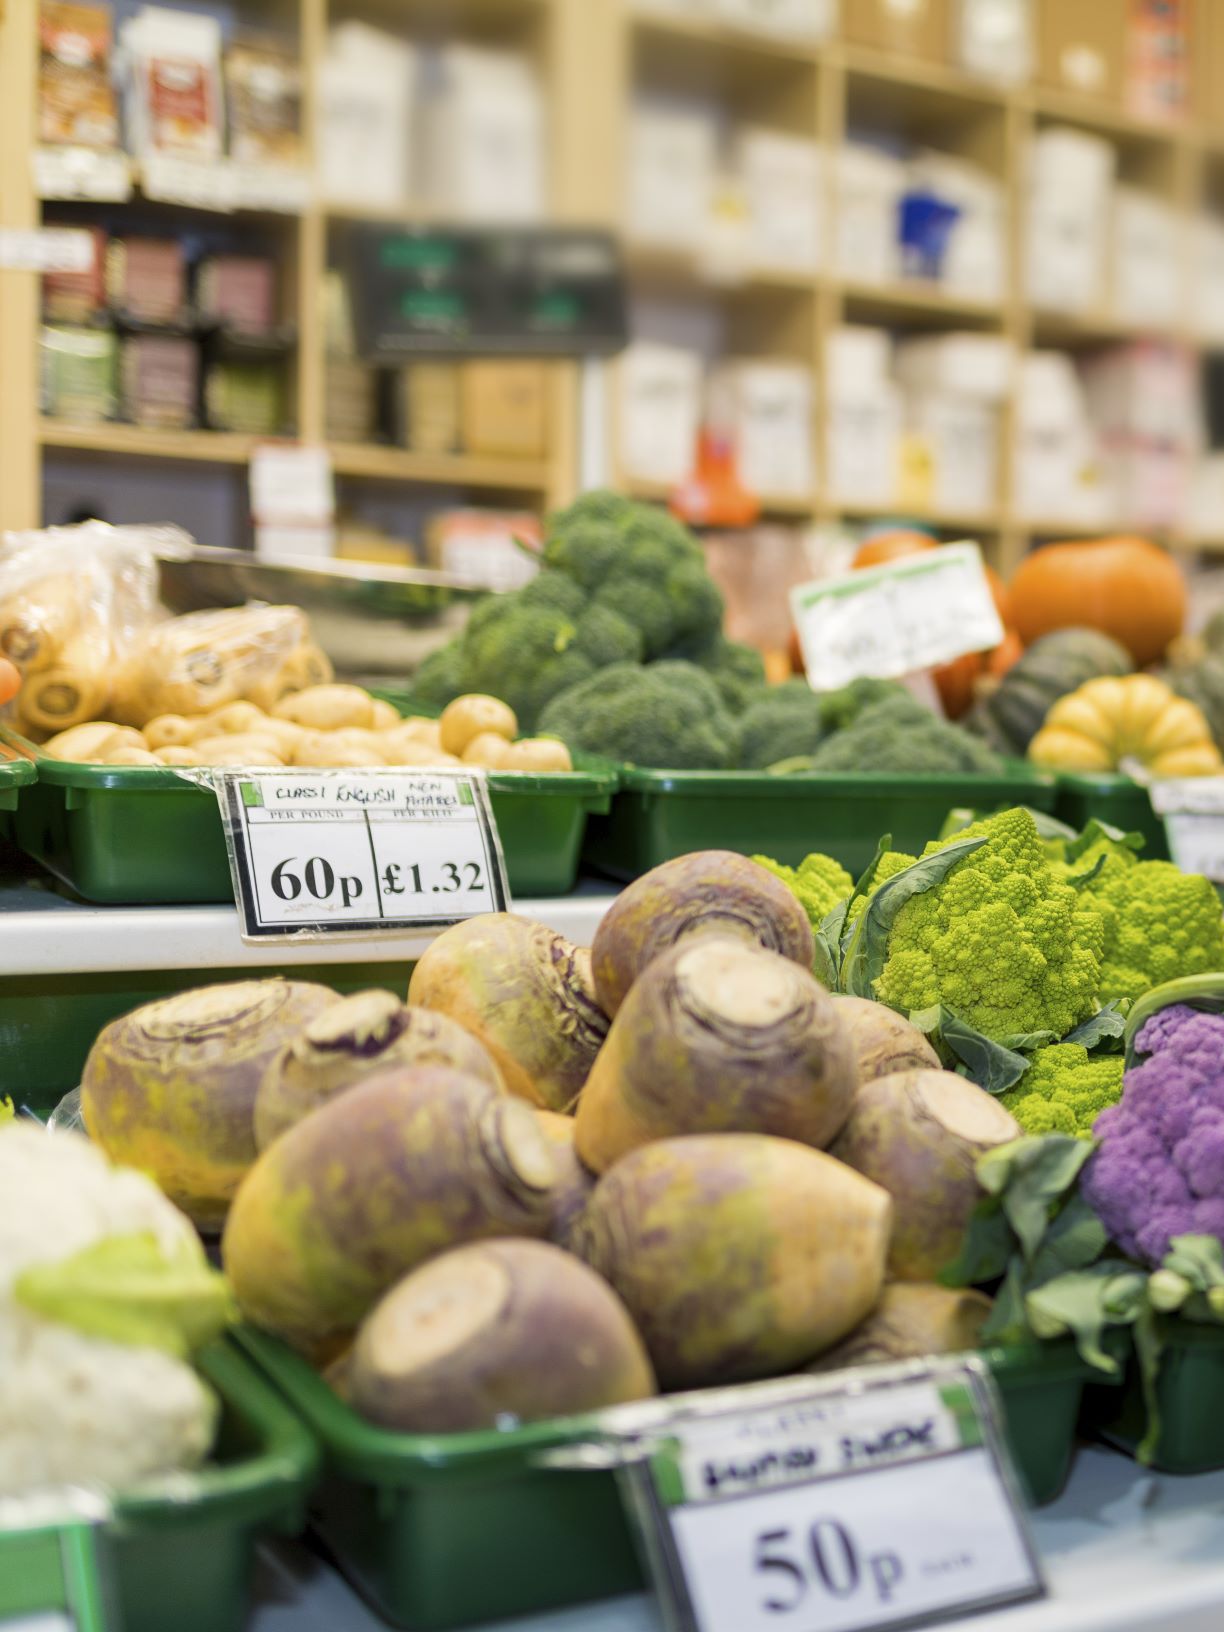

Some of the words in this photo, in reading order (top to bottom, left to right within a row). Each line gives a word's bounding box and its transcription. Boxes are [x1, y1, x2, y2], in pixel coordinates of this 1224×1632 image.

[271, 857, 363, 907] 60p
[382, 862, 485, 895] £1.32
[753, 1514, 904, 1613] 50p
